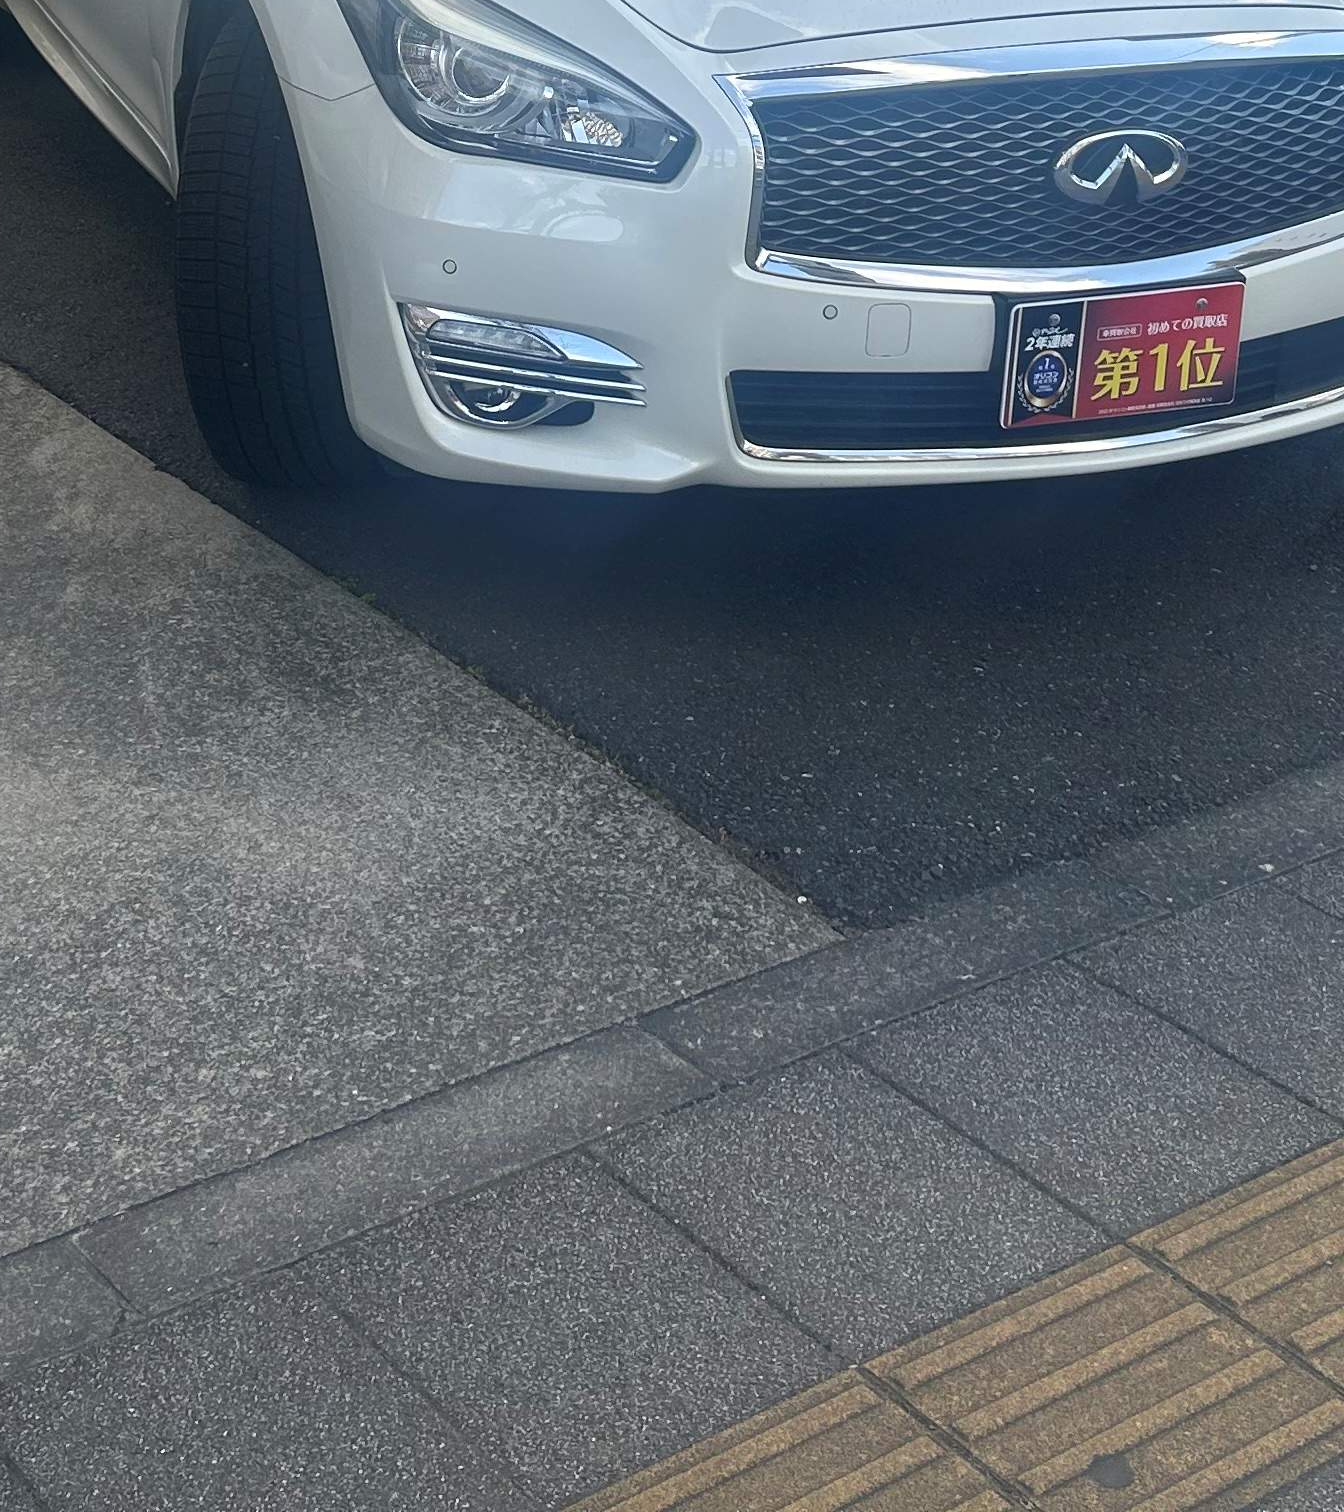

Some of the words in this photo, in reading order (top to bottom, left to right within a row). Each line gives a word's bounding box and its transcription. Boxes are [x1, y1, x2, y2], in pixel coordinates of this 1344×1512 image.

[1147, 313, 1229, 336] 初めての買取店
[1024, 333, 1077, 351] 2年連続
[1090, 338, 1226, 401] 第1位
